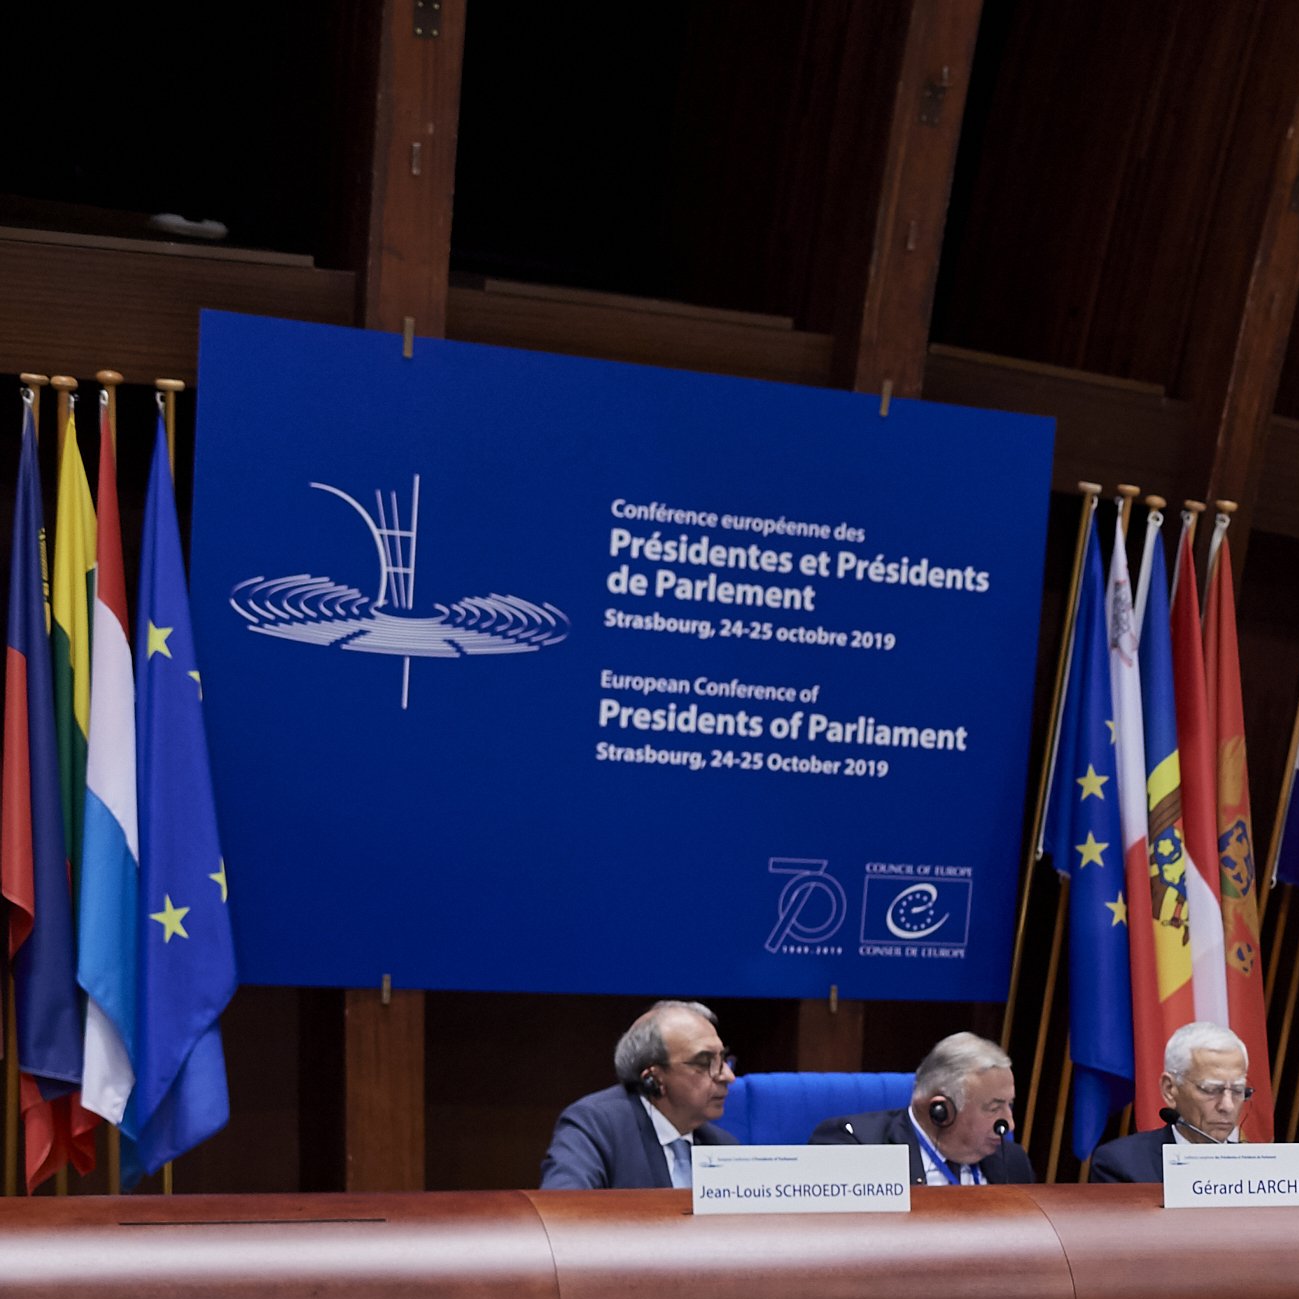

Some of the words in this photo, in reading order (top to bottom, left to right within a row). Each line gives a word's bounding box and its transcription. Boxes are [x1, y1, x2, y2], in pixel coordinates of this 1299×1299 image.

[611, 499, 718, 528] Conférence
[721, 511, 830, 538] européenne
[834, 523, 866, 543] des
[609, 528, 793, 574] Présidentes
[800, 553, 830, 577] et
[837, 551, 990, 592] Présidents
[607, 564, 648, 595] de
[655, 569, 816, 611] Parlement
[603, 608, 716, 640] Strasbourg,
[719, 618, 773, 641] 24-25
[776, 625, 847, 647] octobre
[850, 629, 896, 650] 2019
[600, 669, 690, 695] European
[694, 676, 796, 702] Conference
[799, 685, 820, 704] of
[598, 698, 763, 737] Presidents
[770, 711, 803, 740] of
[807, 714, 968, 751] Parliament
[595, 741, 706, 770] Strasbourg,
[710, 749, 763, 771] 24-25
[767, 753, 840, 776] October
[843, 758, 889, 778] 2019
[865, 862, 914, 875] COUNCIL
[700, 1184, 772, 1199] Jean-Louis
[775, 1183, 904, 1198] SCHROEDT-GIRARD
[1192, 1179, 1243, 1195] Gérard
